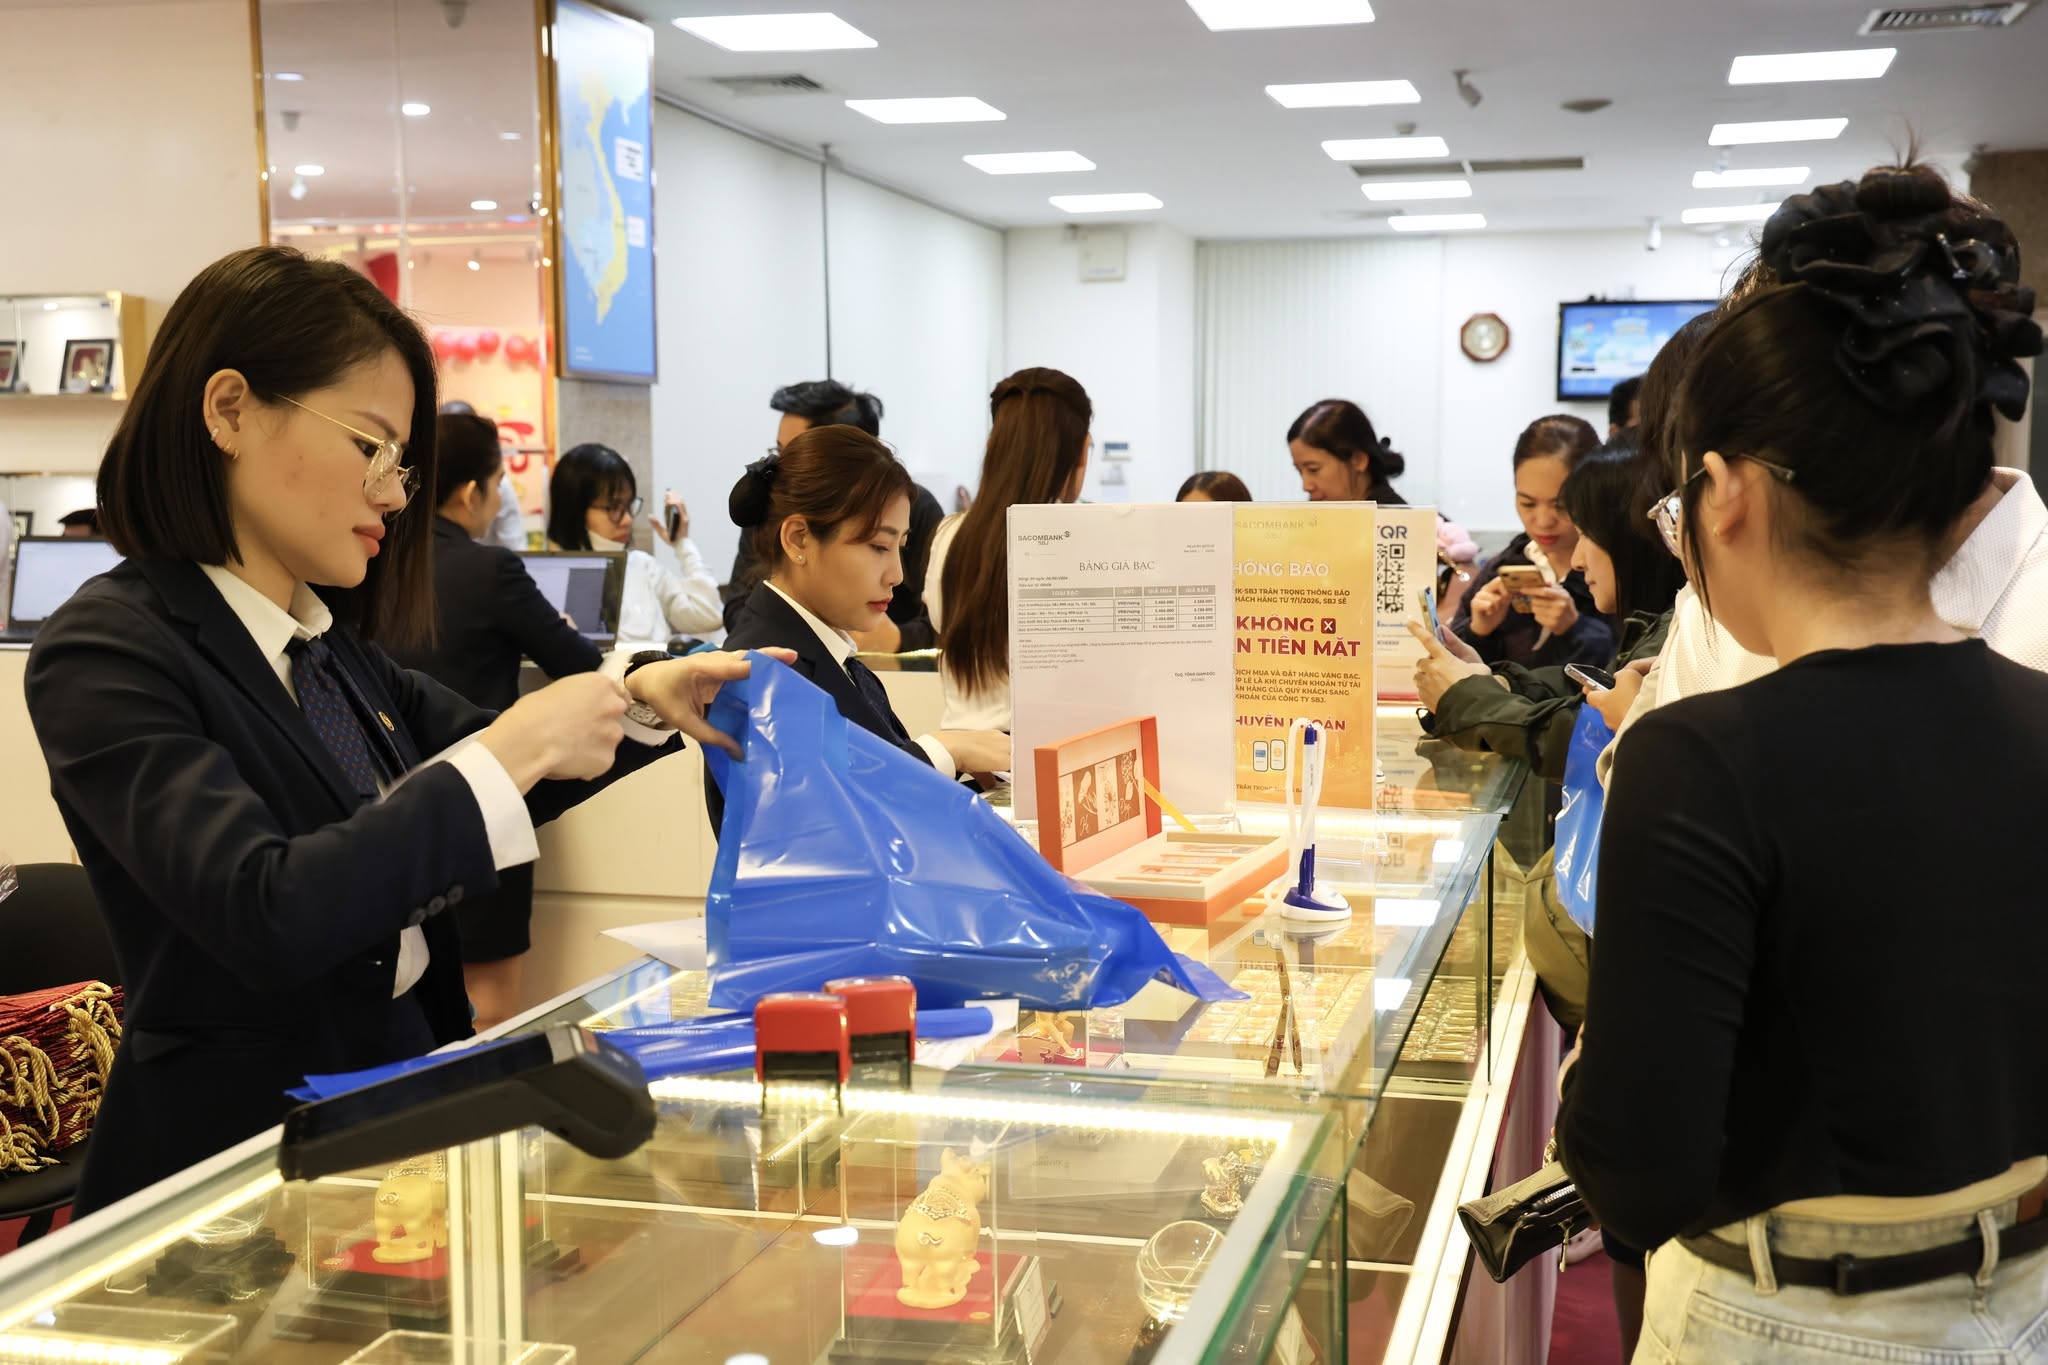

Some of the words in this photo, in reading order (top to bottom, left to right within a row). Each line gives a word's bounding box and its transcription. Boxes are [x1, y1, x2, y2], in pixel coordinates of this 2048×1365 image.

[1380, 525, 1408, 540] QR
[1079, 560, 1109, 572] BẢNG
[1111, 560, 1130, 571] GIÁ
[1133, 559, 1156, 571] BẠC
[1289, 558, 1330, 577] BÁO
[1235, 587, 1258, 595] K-SBJ
[1258, 586, 1279, 595] TRÂN
[1280, 588, 1306, 596] TRỌNG
[1306, 587, 1333, 596] THÔNG
[1333, 588, 1351, 597] BÁO
[1256, 595, 1278, 603] HÀNG
[1279, 596, 1290, 604] TỪ
[1338, 597, 1348, 605] SẼ
[1236, 612, 1315, 633] KHÔNG
[1313, 636, 1361, 660] MẶT
[1270, 669, 1281, 677] VÀ
[1282, 669, 1297, 678] ĐẶT
[1298, 670, 1320, 678] HÀNG
[1320, 671, 1342, 679] VÀNG
[1253, 676, 1263, 684] LÀ
[1309, 678, 1336, 687] KHOẢN
[1337, 679, 1348, 688] TỪ
[1349, 680, 1361, 688] TÀI
[1246, 684, 1267, 693] HÀNG
[1268, 684, 1284, 693] CỦA
[1301, 686, 1328, 695] KHÁCH
[1261, 692, 1277, 701] CỦA
[1278, 693, 1299, 702] CÔNG
[1310, 696, 1327, 704] SBJ.
